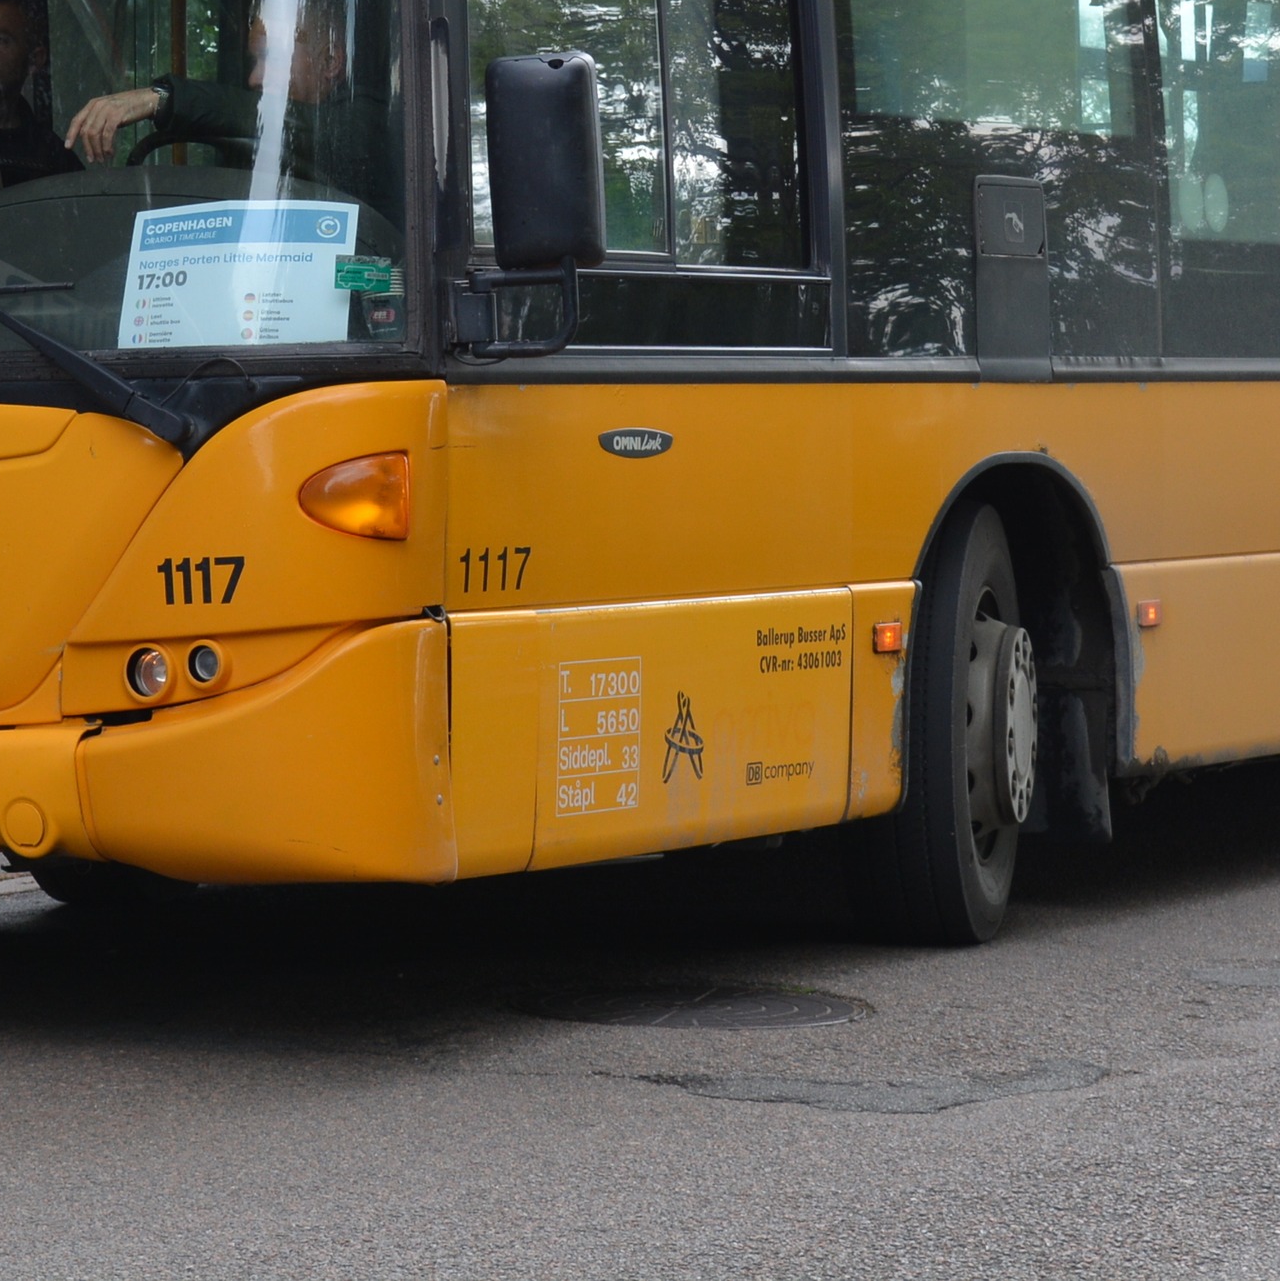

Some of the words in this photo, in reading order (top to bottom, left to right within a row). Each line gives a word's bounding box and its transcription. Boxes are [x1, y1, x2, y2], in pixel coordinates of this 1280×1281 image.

[144, 235, 173, 245] ORARIO
[178, 230, 217, 241] TIMETABLE
[146, 216, 233, 235] COPENHAGEN
[139, 257, 180, 270] Norges
[182, 253, 220, 266] Porten
[223, 252, 254, 264] Little
[256, 252, 314, 264] Mermaid
[137, 270, 188, 290] 17:00
[157, 557, 245, 605] 1117
[459, 547, 531, 594] 1117
[756, 627, 795, 649] Ballerup
[797, 626, 827, 644] Busser
[829, 623, 846, 645] ApS
[759, 655, 795, 674] CVR-nr:
[797, 650, 842, 671] 43061003
[560, 670, 572, 694] T.
[589, 670, 640, 697] 17300
[561, 709, 569, 732] L
[597, 708, 639, 735] 5650
[559, 742, 612, 773] Siddepl.
[622, 745, 639, 769] 33
[746, 762, 762, 784] DB
[764, 760, 815, 781] company
[558, 780, 596, 812] Ståpl
[616, 782, 638, 807] 42
